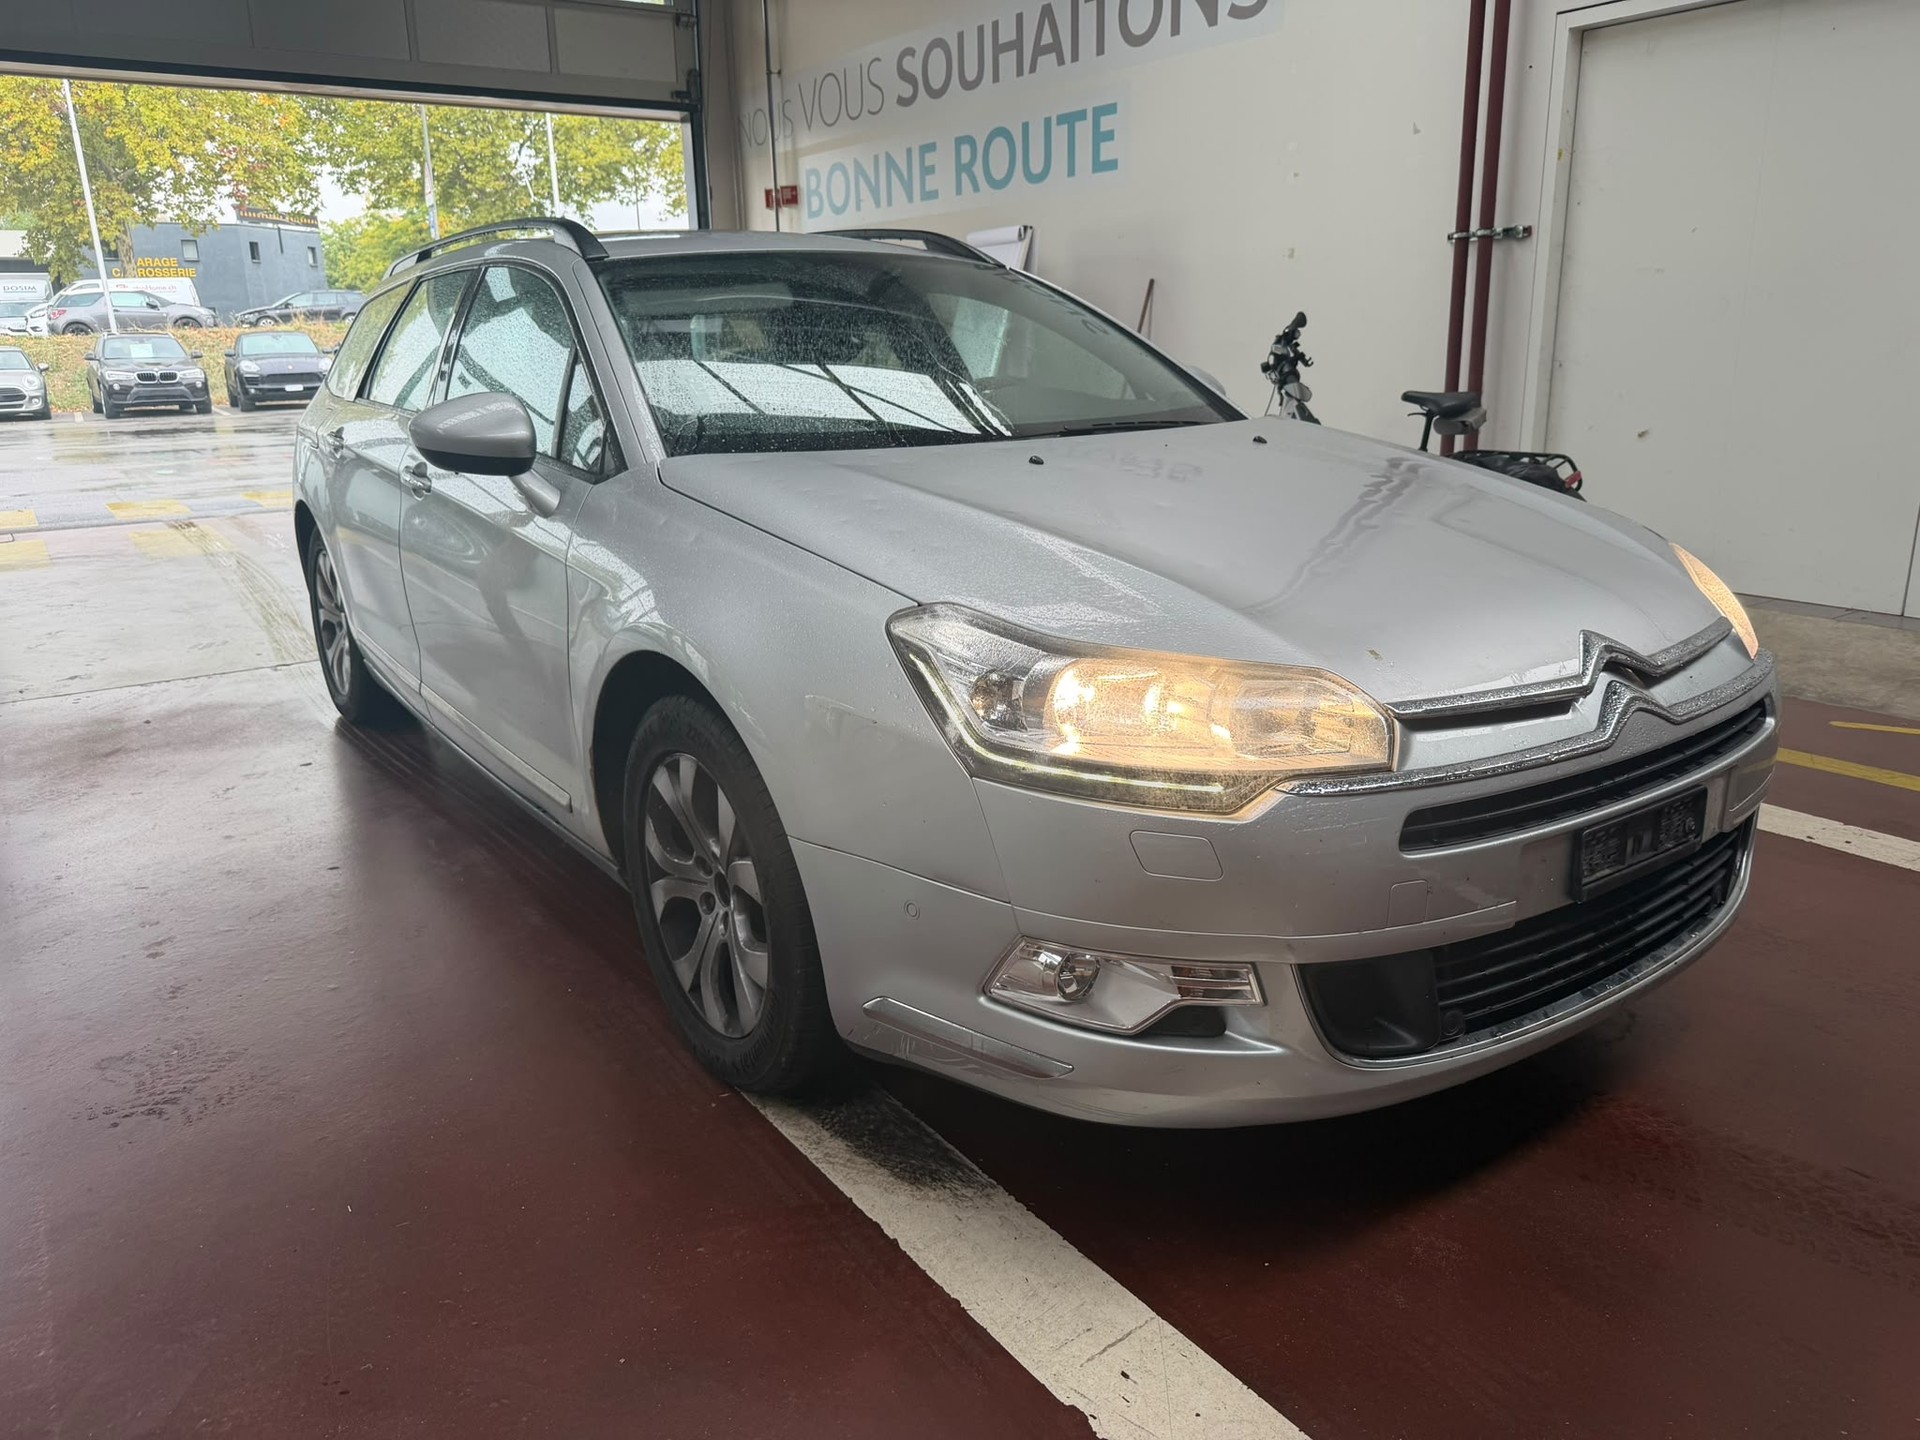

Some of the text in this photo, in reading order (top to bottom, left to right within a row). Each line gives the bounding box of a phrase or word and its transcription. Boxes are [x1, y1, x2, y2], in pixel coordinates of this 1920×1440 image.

[798, 57, 884, 132] VOUS
[805, 102, 1119, 220] BONNE ROUTE
[112, 267, 197, 277] CROSSERIE
[137, 257, 179, 267] ARAGE
